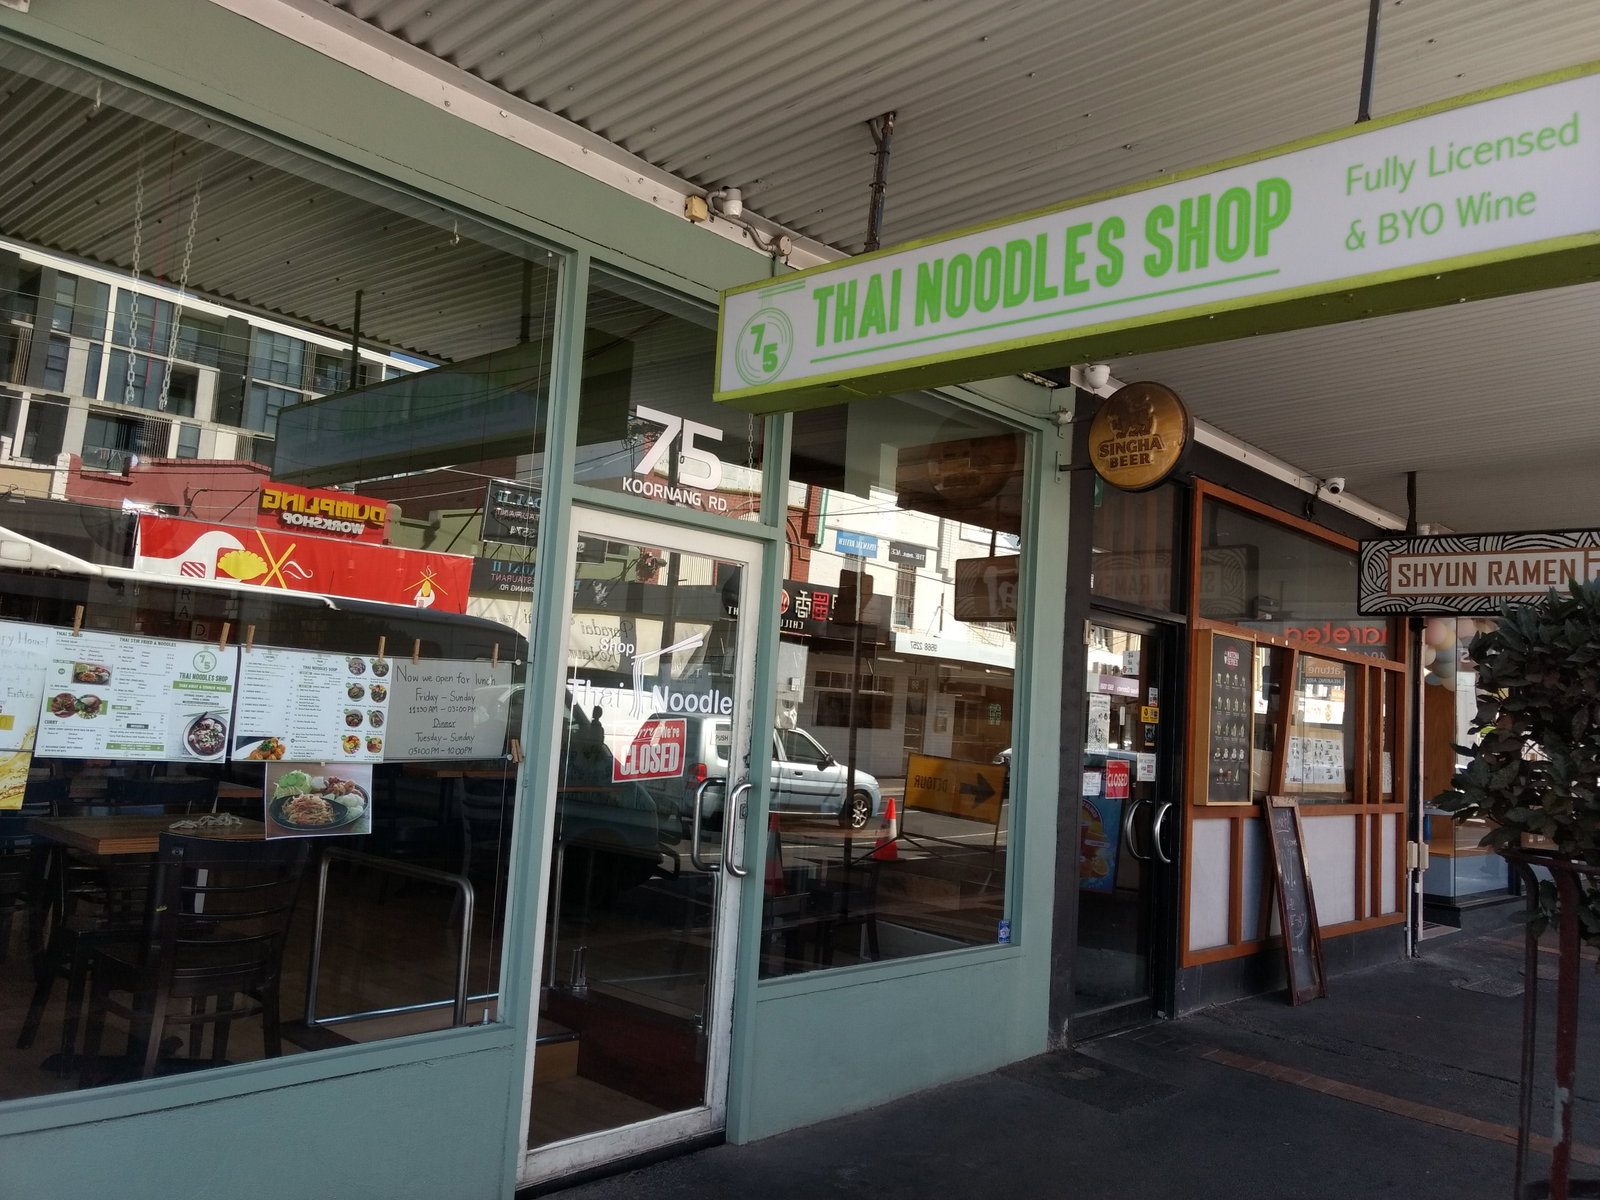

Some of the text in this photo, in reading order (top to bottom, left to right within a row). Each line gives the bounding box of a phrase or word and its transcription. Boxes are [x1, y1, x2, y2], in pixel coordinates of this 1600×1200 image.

[1346, 111, 1580, 196] Fully Licensed
[1345, 190, 1538, 251] & BYO Wine
[812, 176, 1293, 348] THAI NOODLES SHOP
[633, 403, 724, 491] 75
[1099, 436, 1163, 459] SINGHA
[1109, 452, 1151, 469] BEER
[622, 476, 730, 513] KOORNANG RD.
[1398, 561, 1477, 588] SHYUN
[1487, 558, 1576, 587] RAMEN
[600, 637, 635, 657] Shop
[396, 665, 419, 683] Now
[422, 674, 432, 682] we
[435, 674, 454, 685] open
[456, 672, 470, 684] for
[415, 688, 439, 705] Friday
[449, 690, 476, 705] Sunday
[567, 678, 625, 709] Thai
[651, 684, 733, 715] Noodle
[432, 718, 457, 729] Dinner
[661, 726, 680, 739] We're
[415, 732, 441, 745] Tuesday
[450, 732, 475, 745] Sunday
[619, 742, 680, 776] CLOSED
[1107, 773, 1128, 788] CLOSED
